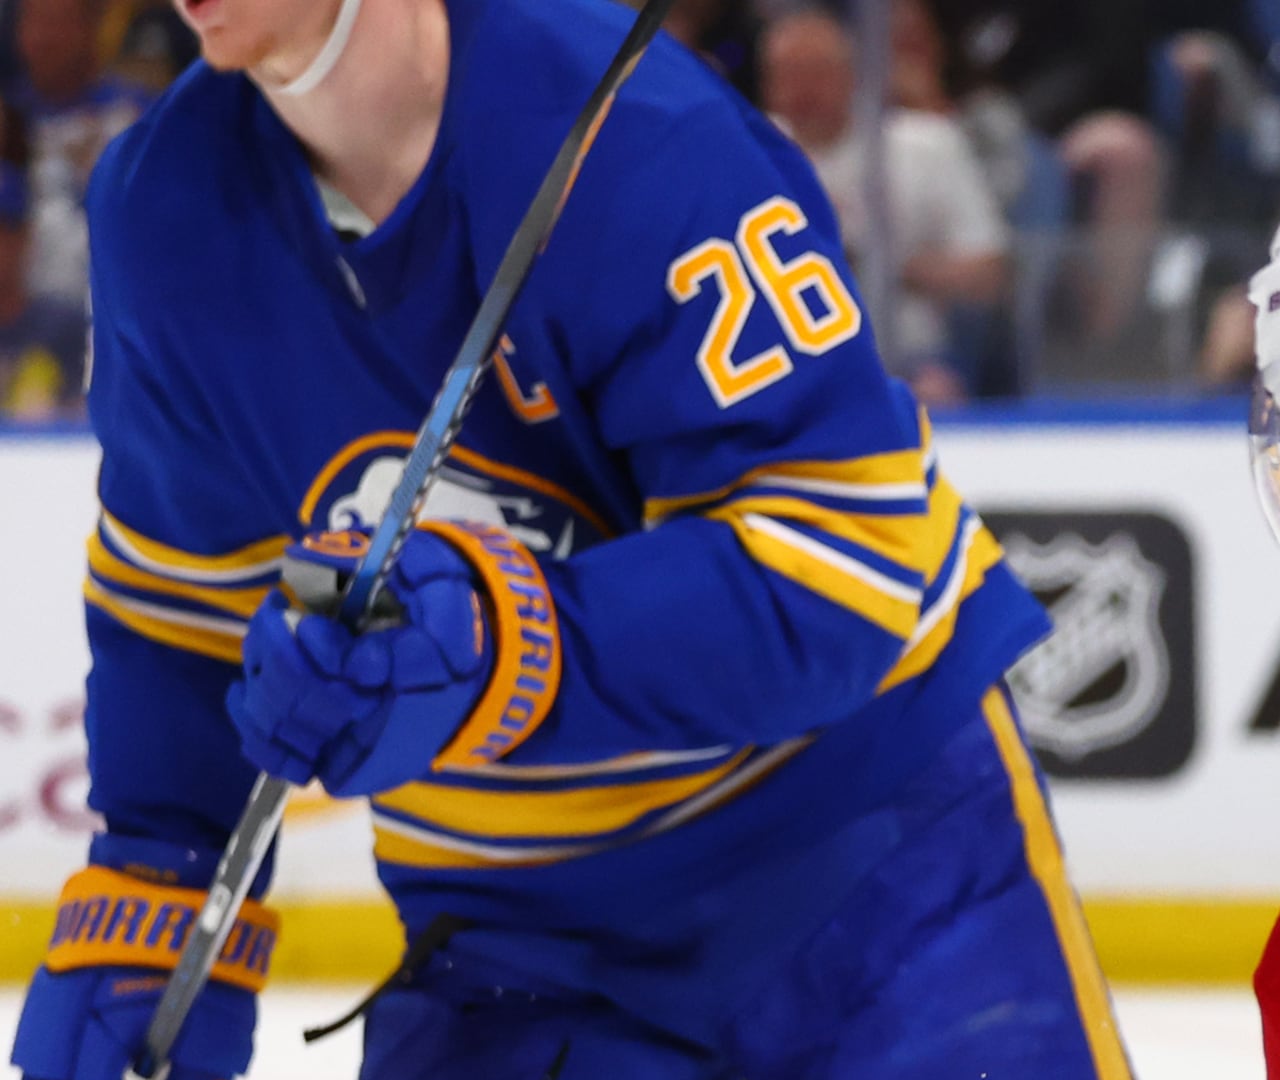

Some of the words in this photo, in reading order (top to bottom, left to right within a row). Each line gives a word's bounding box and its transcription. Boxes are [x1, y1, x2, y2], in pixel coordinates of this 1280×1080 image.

[666, 194, 862, 410] 26
[492, 333, 560, 424] C
[50, 895, 277, 978] WARROR
